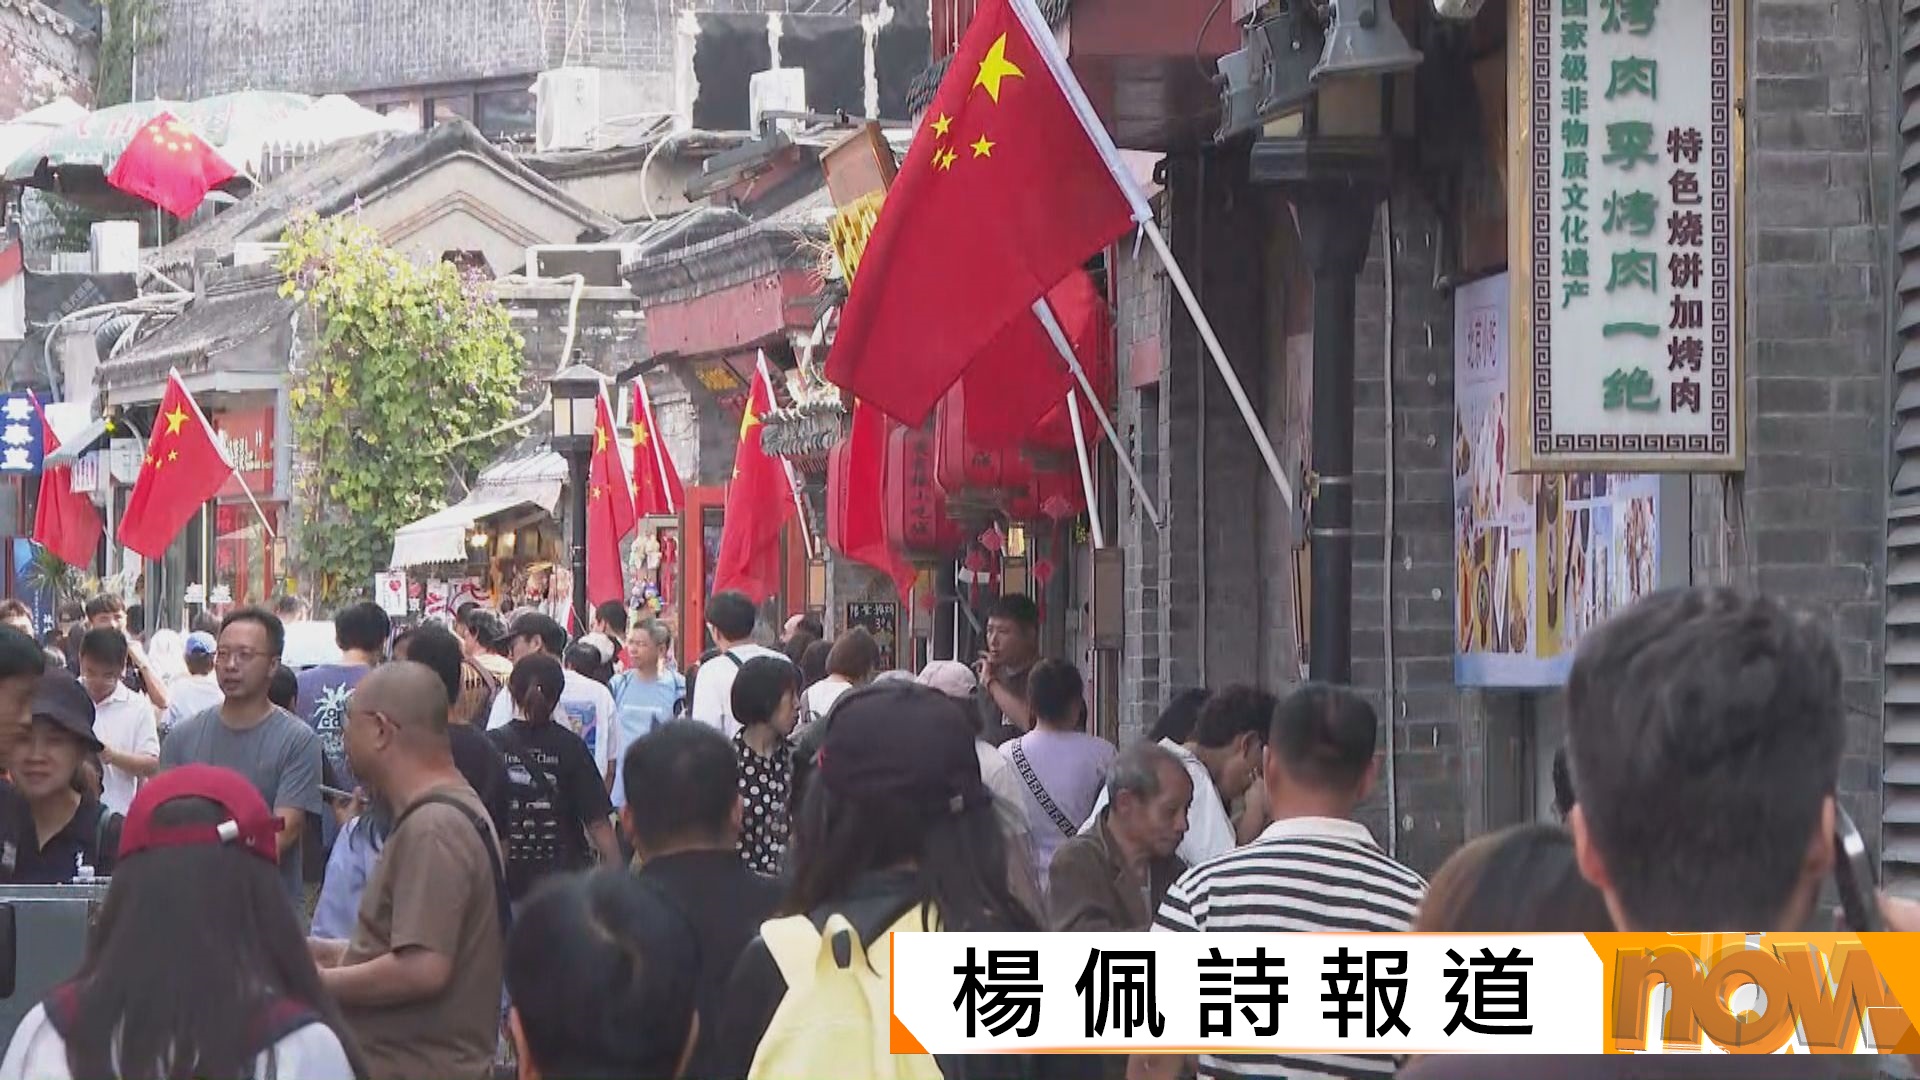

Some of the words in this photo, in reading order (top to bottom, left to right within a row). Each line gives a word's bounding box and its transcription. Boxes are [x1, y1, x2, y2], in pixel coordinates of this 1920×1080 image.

[1667, 127, 1703, 414] 特色烧饼加烤肉
